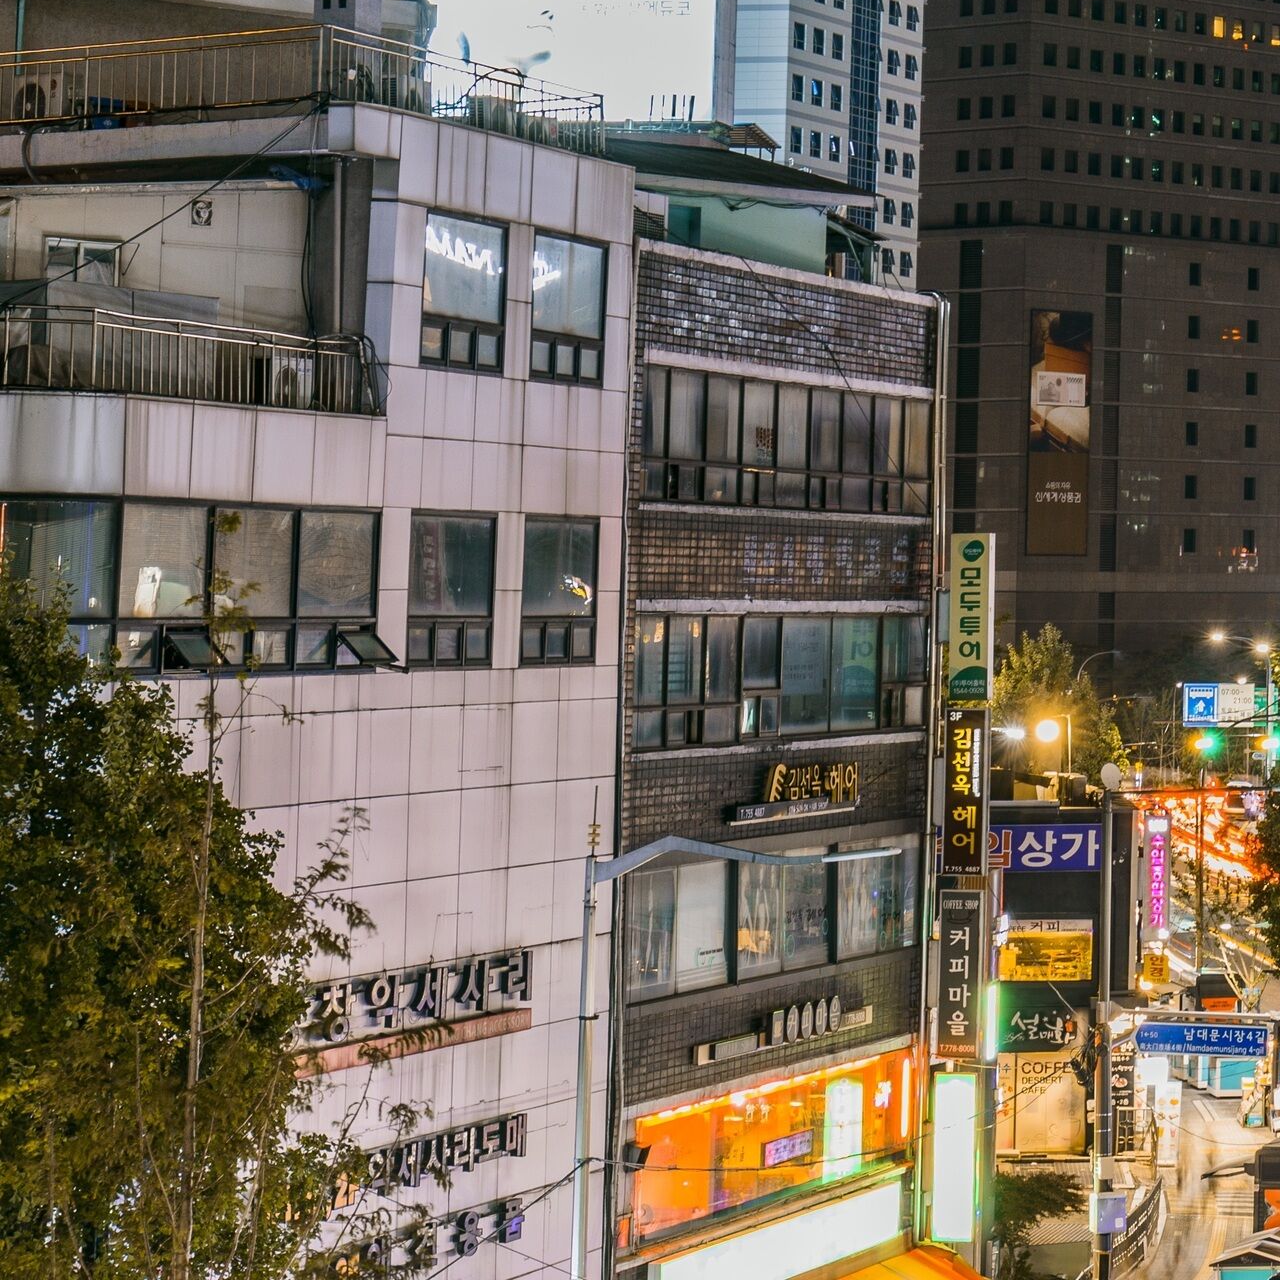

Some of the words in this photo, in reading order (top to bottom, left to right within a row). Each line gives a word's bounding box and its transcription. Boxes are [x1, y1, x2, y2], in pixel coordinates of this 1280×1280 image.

[959, 567, 981, 661] 모두투어
[950, 712, 962, 721] 3F
[952, 728, 972, 796] 김선옥
[789, 764, 821, 800] 김선옥
[830, 762, 858, 803] 헤어
[952, 806, 976, 855] 헤어
[943, 899, 963, 909] COFFEE
[965, 899, 979, 909] SHOP
[946, 927, 972, 1036] 커피마을
[787, 1001, 840, 1040] 커피마을
[1184, 1027, 1265, 1044] 남대문시장4길
[940, 1043, 976, 1053] T.778-8008
[1187, 1043, 1247, 1055] Namdaemunsijang
[1249, 1045, 1265, 1055] 4-gil
[1021, 1076, 1063, 1085] DESSERT
[1021, 1087, 1045, 1095] CAFE
